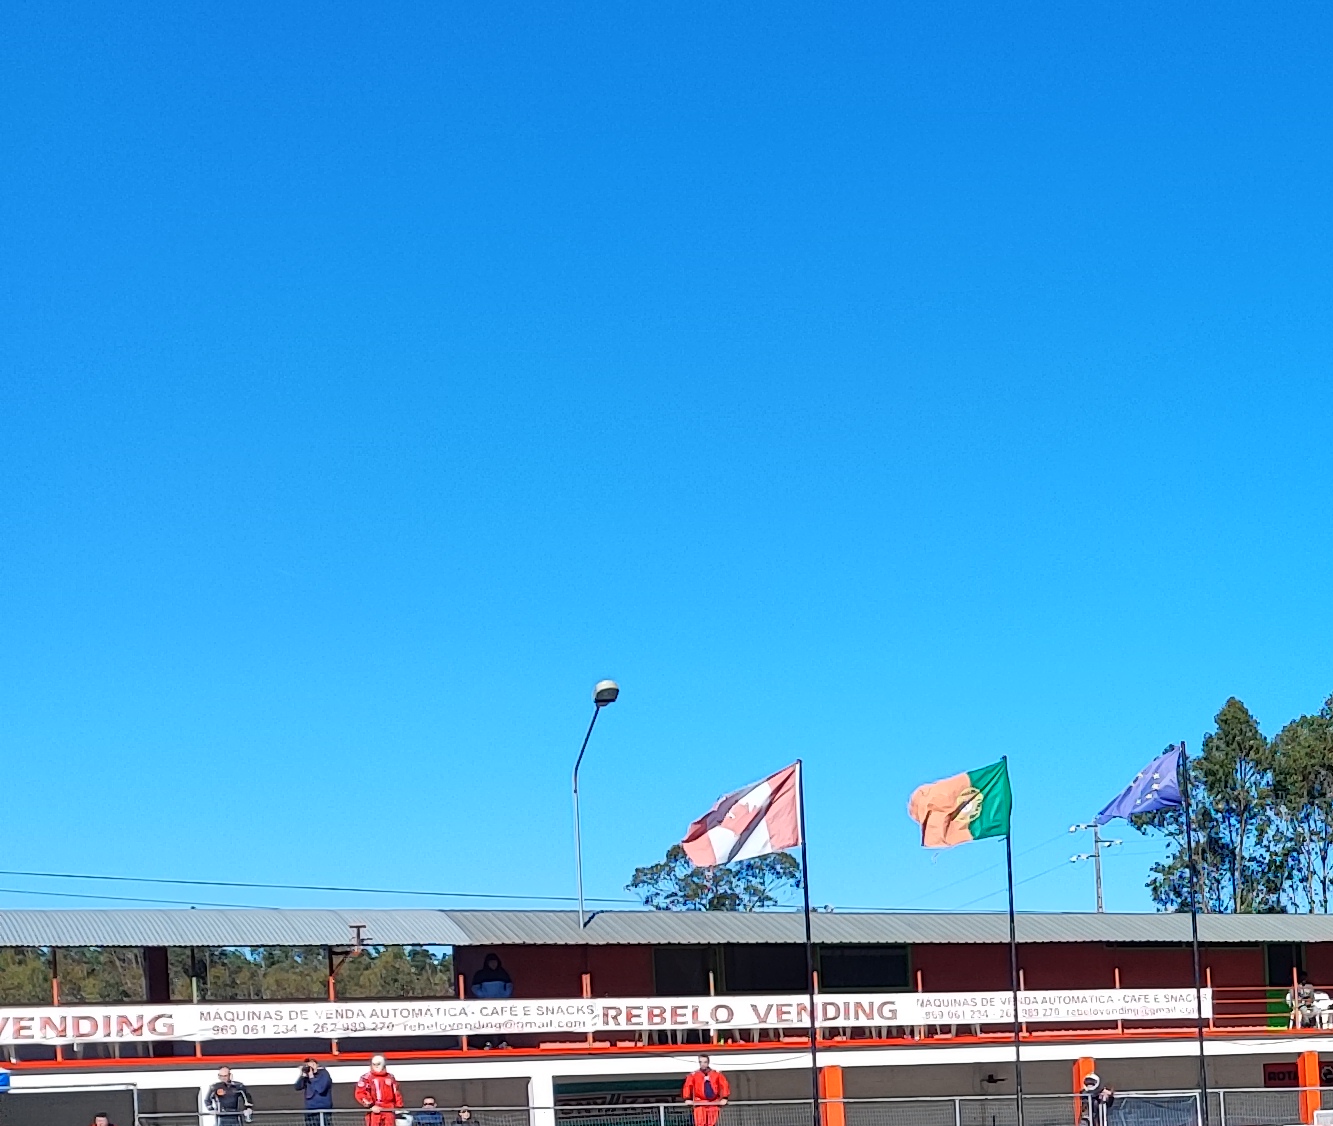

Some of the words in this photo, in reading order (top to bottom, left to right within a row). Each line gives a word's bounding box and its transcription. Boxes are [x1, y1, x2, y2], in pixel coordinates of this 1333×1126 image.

[981, 997, 996, 1007] DE
[200, 1009, 283, 1022] MÁQUINAS
[288, 1009, 309, 1021] DE
[315, 1008, 366, 1020] VENDA
[369, 1004, 468, 1019] AUTOMÁTICA
[479, 1004, 518, 1017] CAFÉ
[523, 1005, 531, 1016] E
[536, 1004, 595, 1016] SNACKS
[602, 1004, 735, 1026] REBELO
[750, 1001, 897, 1023] VENDING
[211, 1024, 238, 1035] 969
[242, 1024, 266, 1035] 061
[273, 1024, 298, 1034] 234
[313, 1022, 337, 1033] 262
